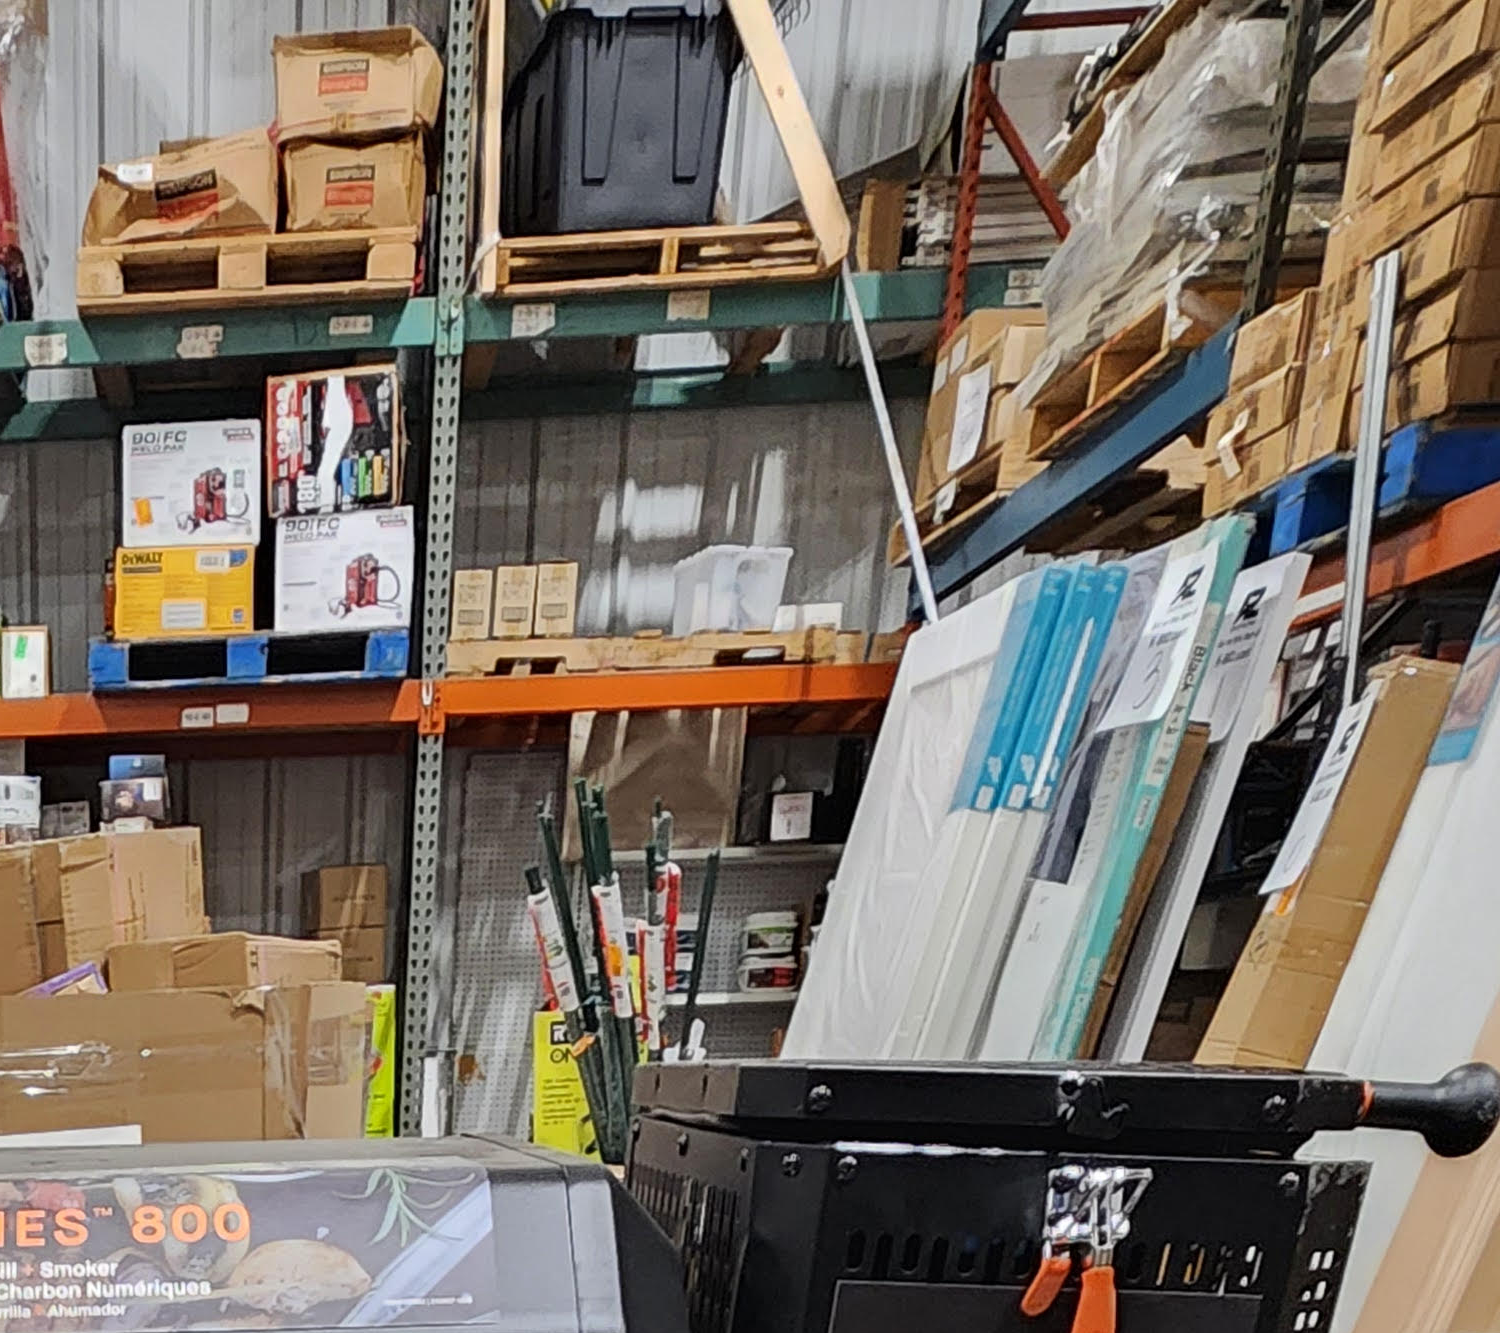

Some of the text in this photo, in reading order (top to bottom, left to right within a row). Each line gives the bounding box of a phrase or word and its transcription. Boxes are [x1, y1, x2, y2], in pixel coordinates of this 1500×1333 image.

[131, 1203, 250, 1244] 800
[39, 1260, 118, 1278] Smoker
[86, 1279, 212, 1300] Numériques
[46, 1302, 127, 1319] Ahumador
